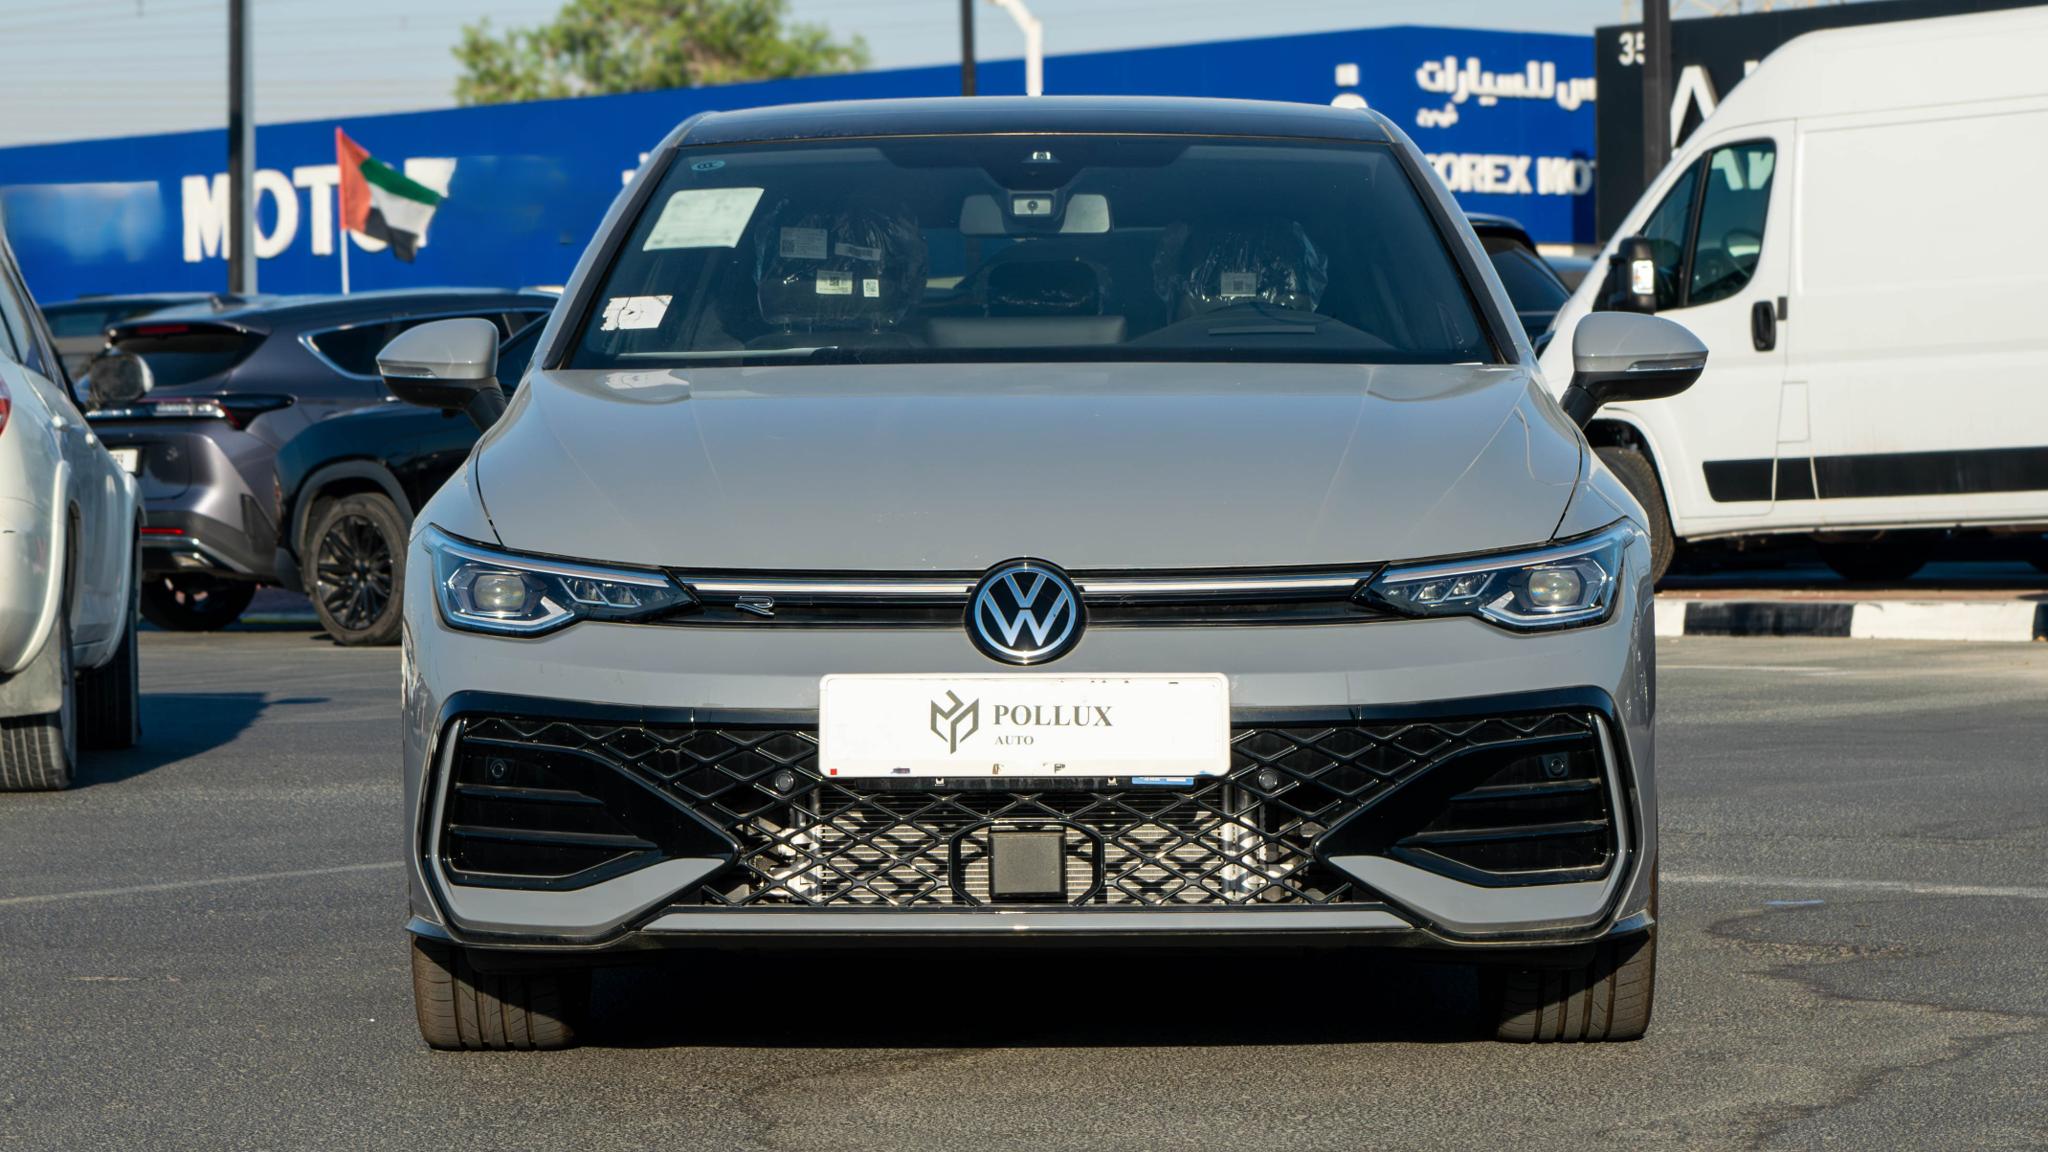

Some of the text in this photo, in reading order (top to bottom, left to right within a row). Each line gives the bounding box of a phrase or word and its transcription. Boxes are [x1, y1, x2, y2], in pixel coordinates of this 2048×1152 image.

[1415, 55, 1556, 107] للسيارات
[1537, 156, 1597, 195] MO
[181, 157, 457, 262] MOT
[993, 704, 1113, 727] POLLUX
[994, 735, 1035, 746] AUTO
